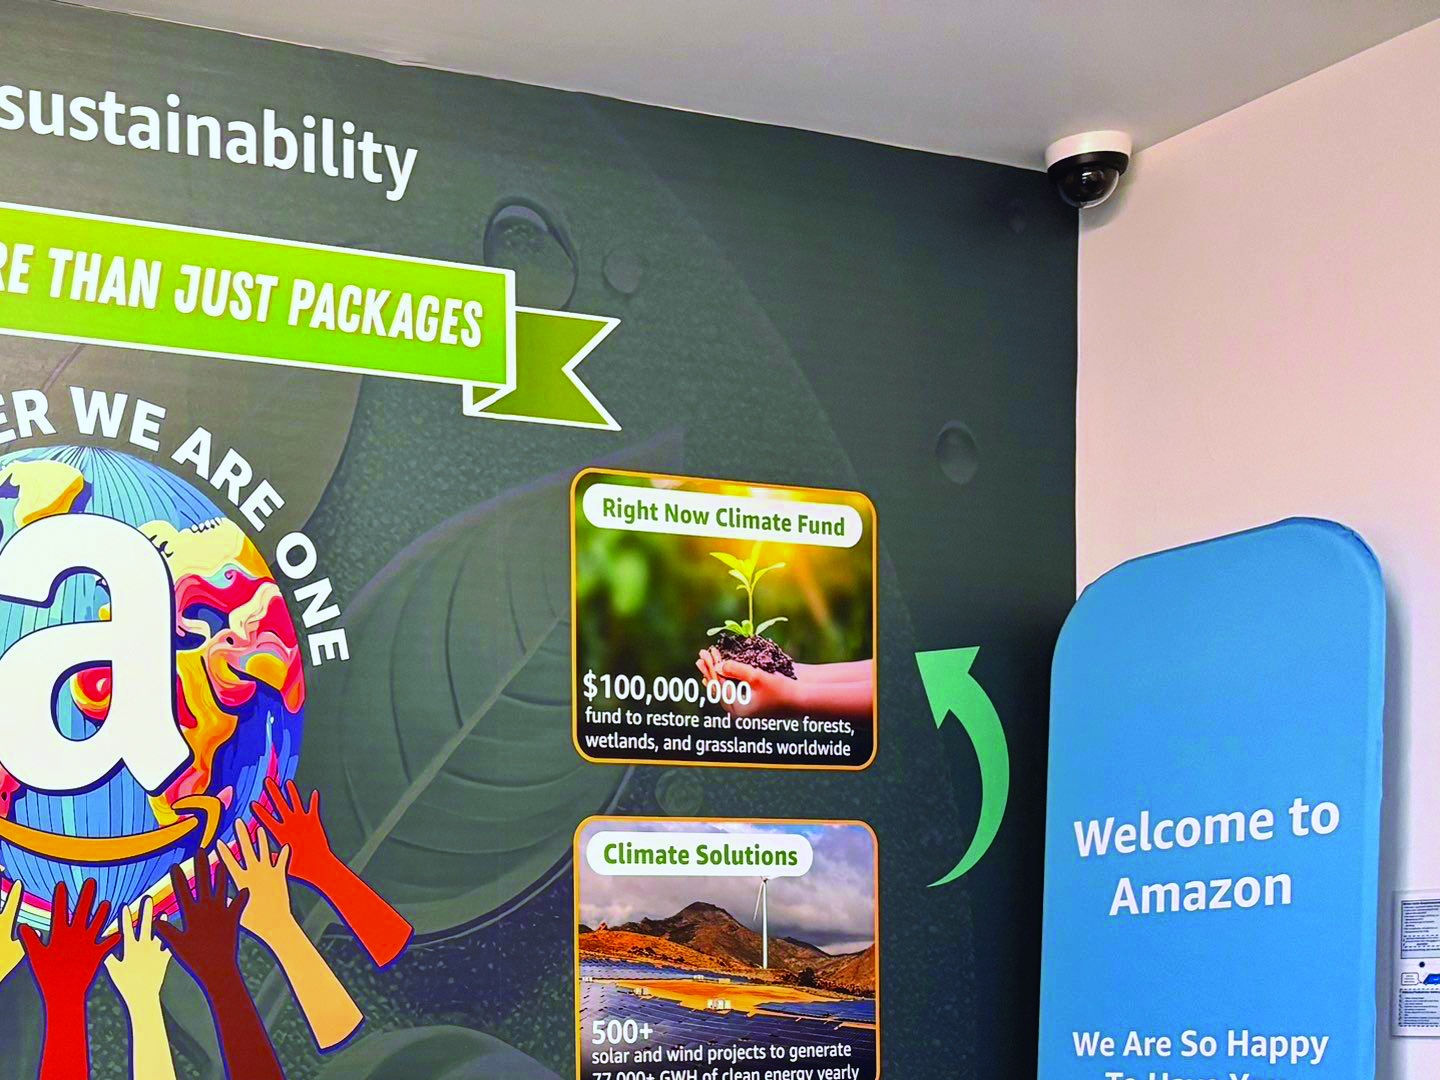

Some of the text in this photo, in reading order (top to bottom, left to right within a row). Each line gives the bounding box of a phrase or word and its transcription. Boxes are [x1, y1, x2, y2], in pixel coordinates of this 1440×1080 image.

[48, 248, 162, 310] THAN
[174, 264, 278, 324] JUST
[288, 278, 483, 348] PACKAGES
[69, 385, 167, 452] WE
[172, 427, 285, 532] ARE
[274, 530, 351, 668] ONE
[602, 498, 846, 537] Right Now Climate Fund
[582, 669, 752, 706] $100,000,000
[585, 706, 855, 737] fund to restore and conserve forests,
[585, 733, 851, 756] wetlands, and grasslands worldwide
[1073, 797, 1340, 857] Welcome to
[603, 842, 798, 866] Climate Solutions
[1109, 871, 1292, 916] Amazon
[591, 1019, 653, 1045] 500+
[1072, 1029, 1329, 1065] We Are So Happy
[591, 1042, 851, 1064] solar and wind projects to generate
